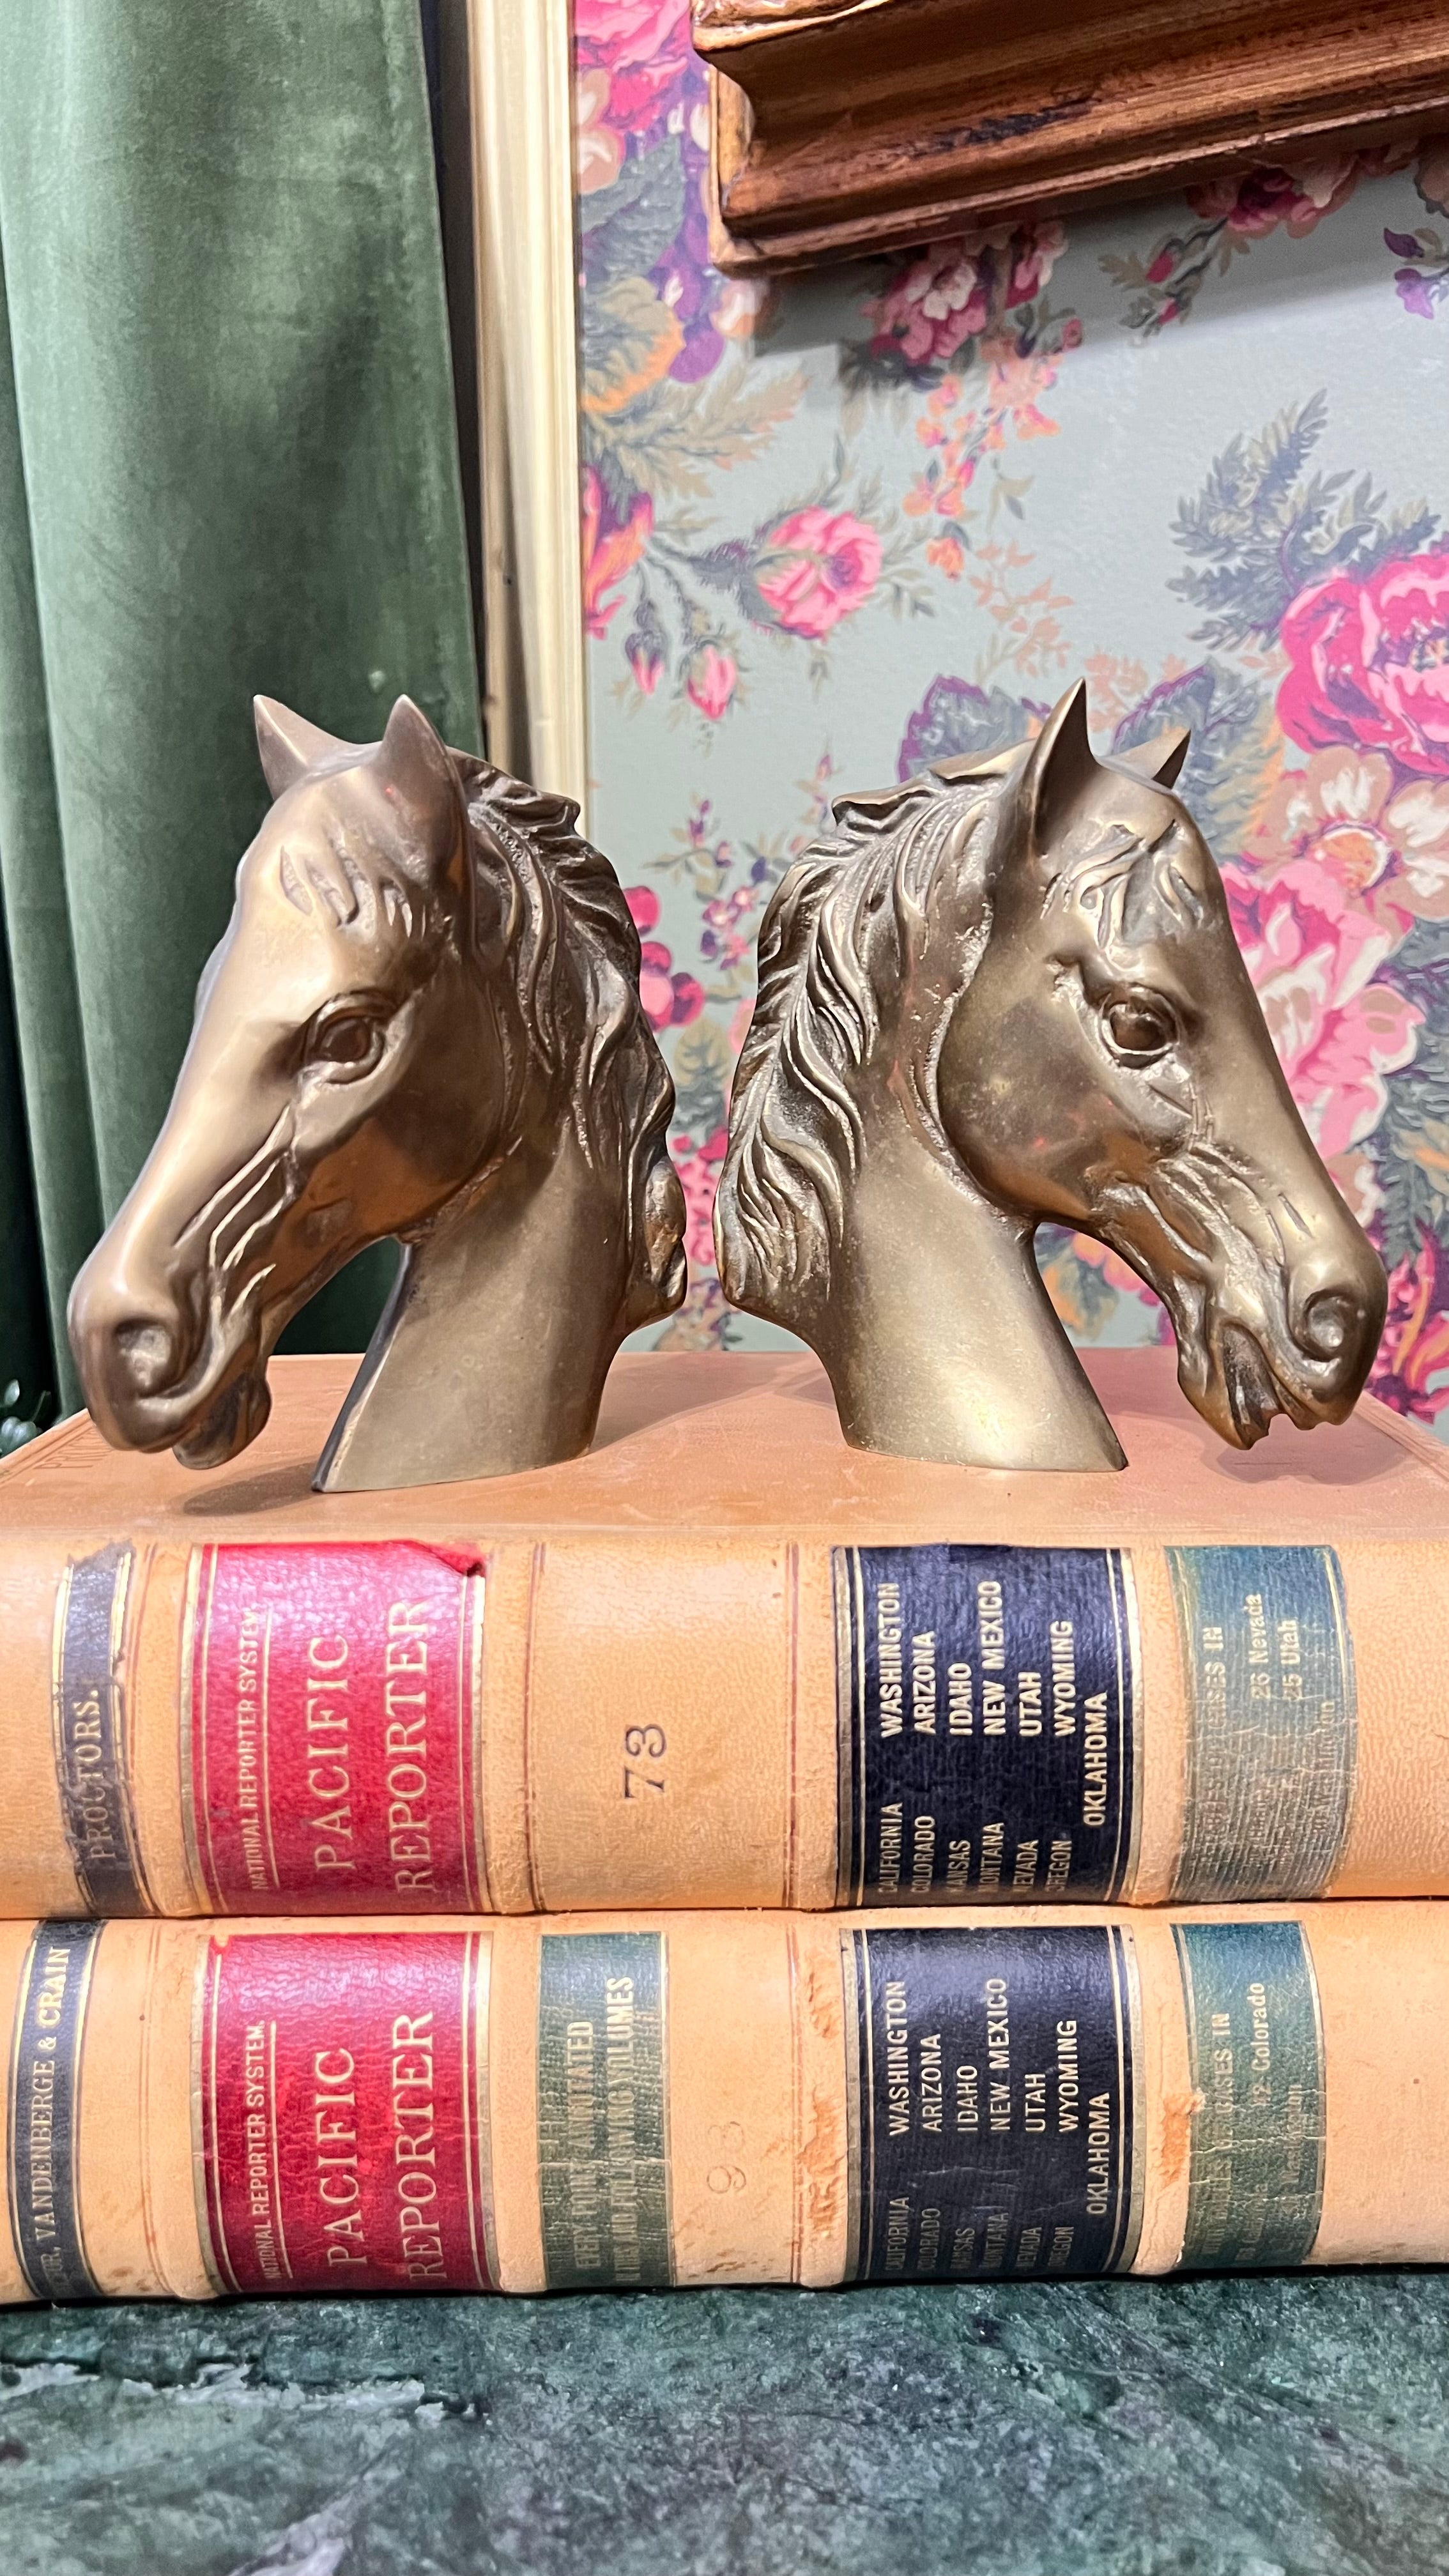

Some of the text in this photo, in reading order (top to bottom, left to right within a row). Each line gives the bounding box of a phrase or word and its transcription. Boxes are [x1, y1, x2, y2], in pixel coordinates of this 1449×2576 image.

[877, 1582, 903, 1738] WASHINGTON
[977, 1580, 1006, 1735] NEW MEXICO
[1204, 1627, 1223, 1651] IN
[1245, 1593, 1269, 1664] Nevada
[1277, 1620, 1301, 1666] Utah
[912, 1630, 937, 1735] ARIZONA
[947, 1662, 973, 1736] IDAHO
[1018, 1671, 1043, 1737] UTAH
[1050, 1620, 1076, 1737] WYOMING
[237, 1699, 257, 1810] REPORTER
[306, 1634, 356, 1873] PACIFIC
[385, 1598, 434, 1893] REPORTER
[624, 1724, 666, 1799] 73
[1083, 1691, 1108, 1827] OKLAHOMA
[241, 1812, 269, 1890] NATIONAL
[878, 1802, 903, 1894] CALIFORNIA
[910, 1815, 935, 1894] COLORADO
[1045, 1839, 1073, 1893] OREGON
[606, 1976, 635, 2084] VOLUMES
[885, 1981, 910, 2136] WASHINGTON
[986, 1978, 1011, 2131] NEW MEXICO
[1211, 2013, 1230, 2036] IN
[1246, 1982, 1270, 2071] Colorado
[31, 1947, 71, 2241] VANDENBERGE & CRAIN
[567, 2021, 595, 2149] ANNOTATED
[921, 2033, 942, 2133] ARIZONA
[956, 2065, 979, 2133] IDAHO
[1025, 2073, 1046, 2133] UTAH
[1057, 2020, 1079, 2133] WYOMING
[1213, 2048, 1234, 2113] CASES
[247, 2113, 270, 2214] REPORTER
[313, 2048, 367, 2267] PACIFIC
[391, 2012, 447, 2280] REPORTER
[1087, 2092, 1110, 2214] OKLAHOMA
[254, 2220, 282, 2280] NATIONAL
[574, 2225, 601, 2269] EVERY
[610, 2212, 639, 2243] AND
[885, 2196, 910, 2271] CALIFORNIA
[917, 2207, 941, 2271] COLORADO
